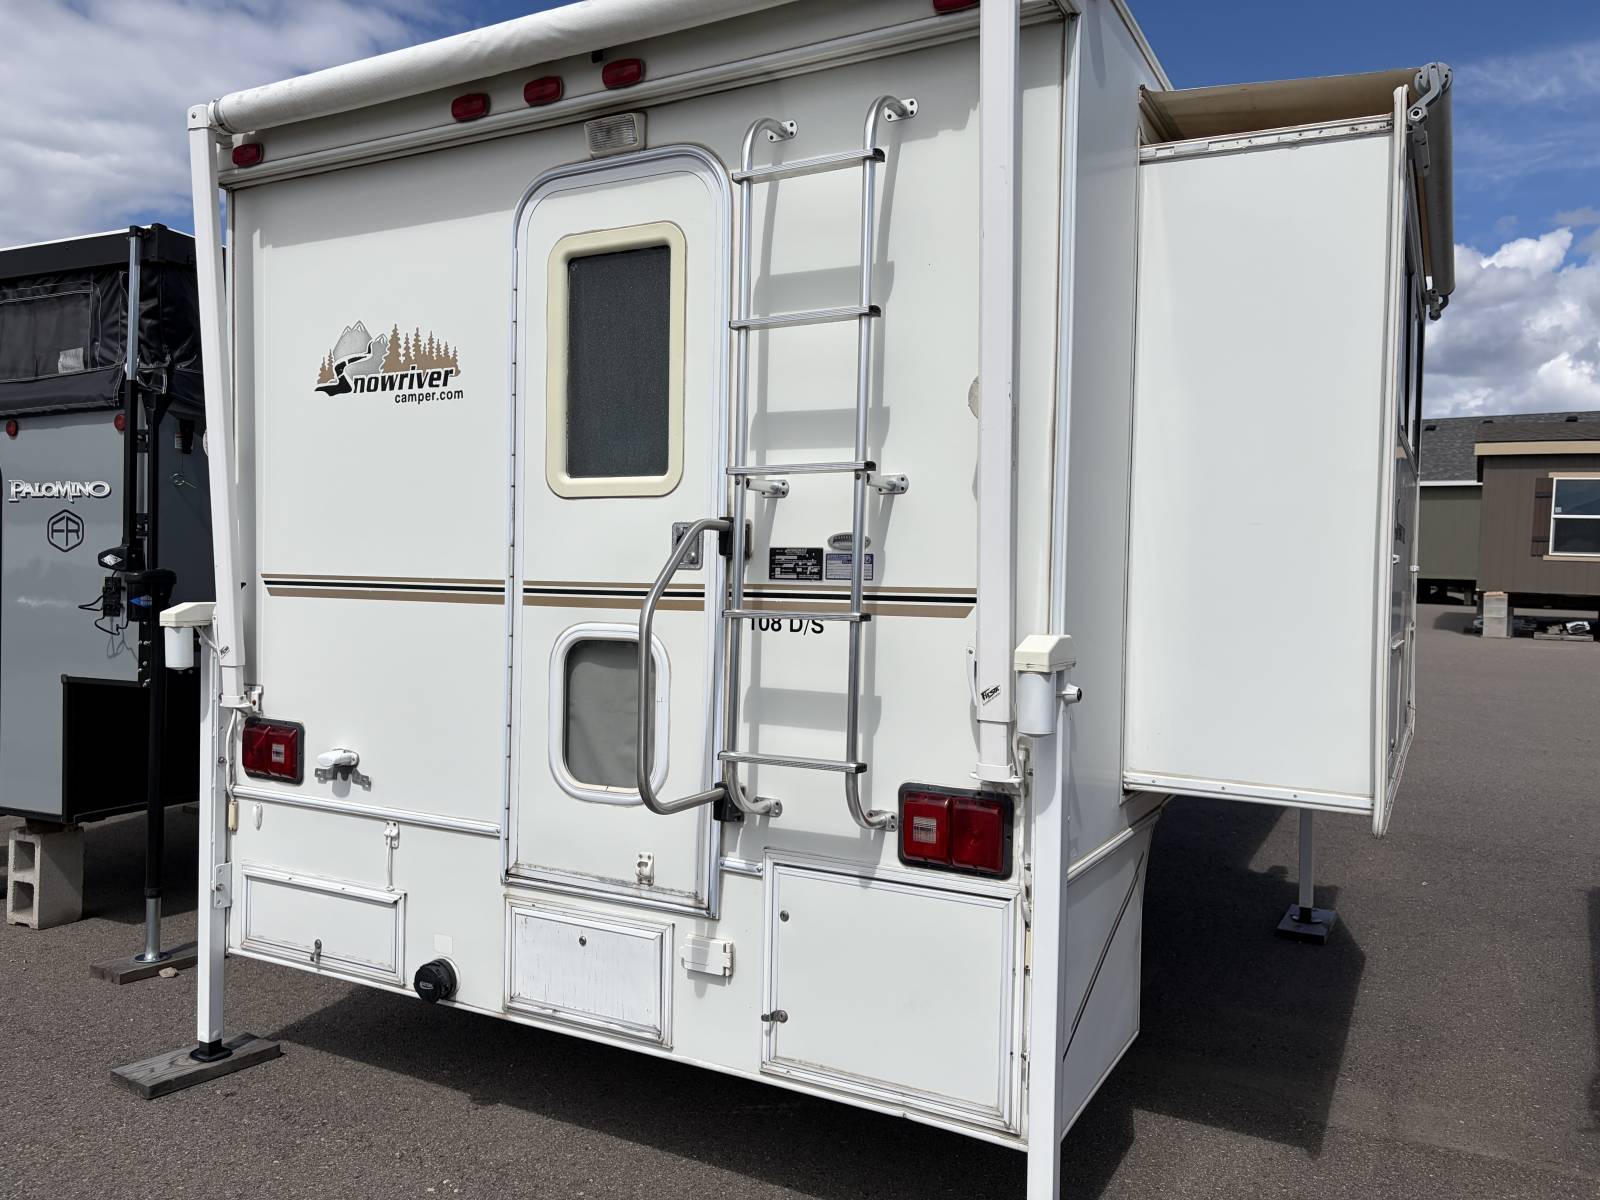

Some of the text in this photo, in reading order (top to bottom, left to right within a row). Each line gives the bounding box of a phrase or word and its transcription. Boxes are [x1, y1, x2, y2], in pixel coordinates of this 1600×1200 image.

[314, 353, 454, 396] Snowriver
[395, 389, 464, 404] camper.com
[789, 618, 825, 636] D/S
